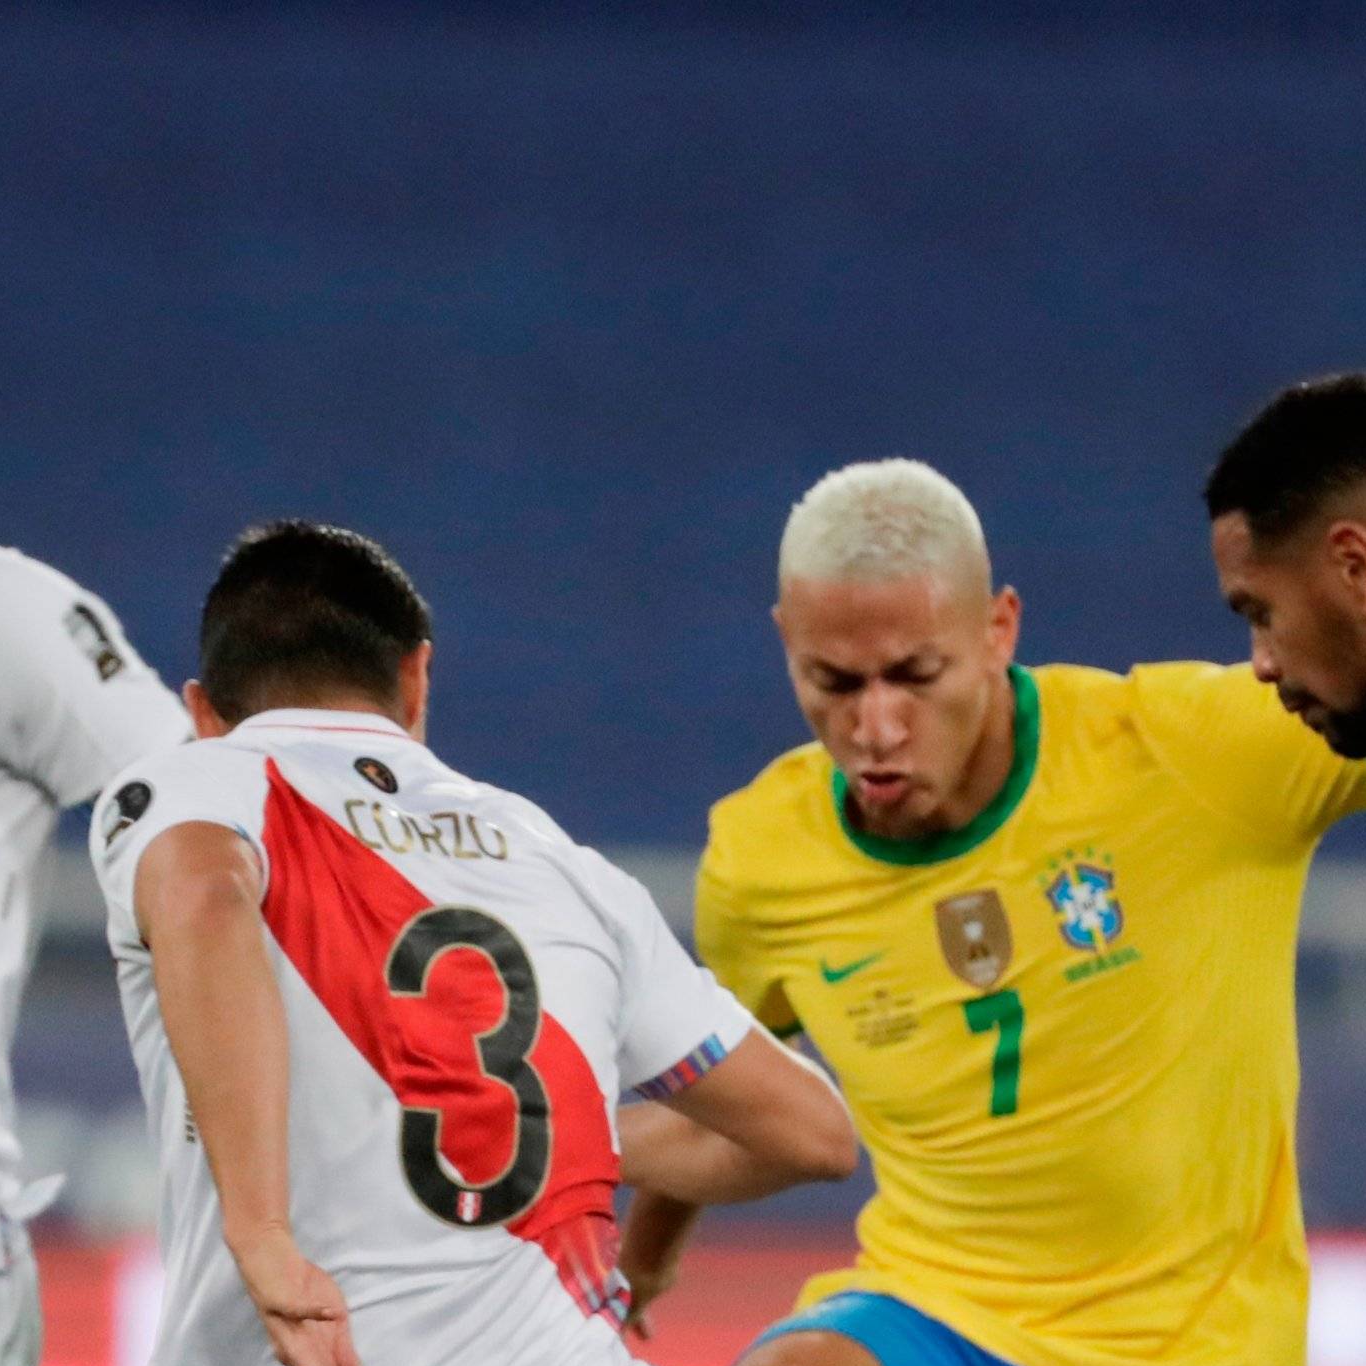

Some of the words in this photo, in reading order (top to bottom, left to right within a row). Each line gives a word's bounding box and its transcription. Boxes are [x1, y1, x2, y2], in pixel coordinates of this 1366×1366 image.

[344, 798, 508, 862] CORZO
[385, 903, 552, 1231] 3
[962, 987, 1025, 1117] 7
